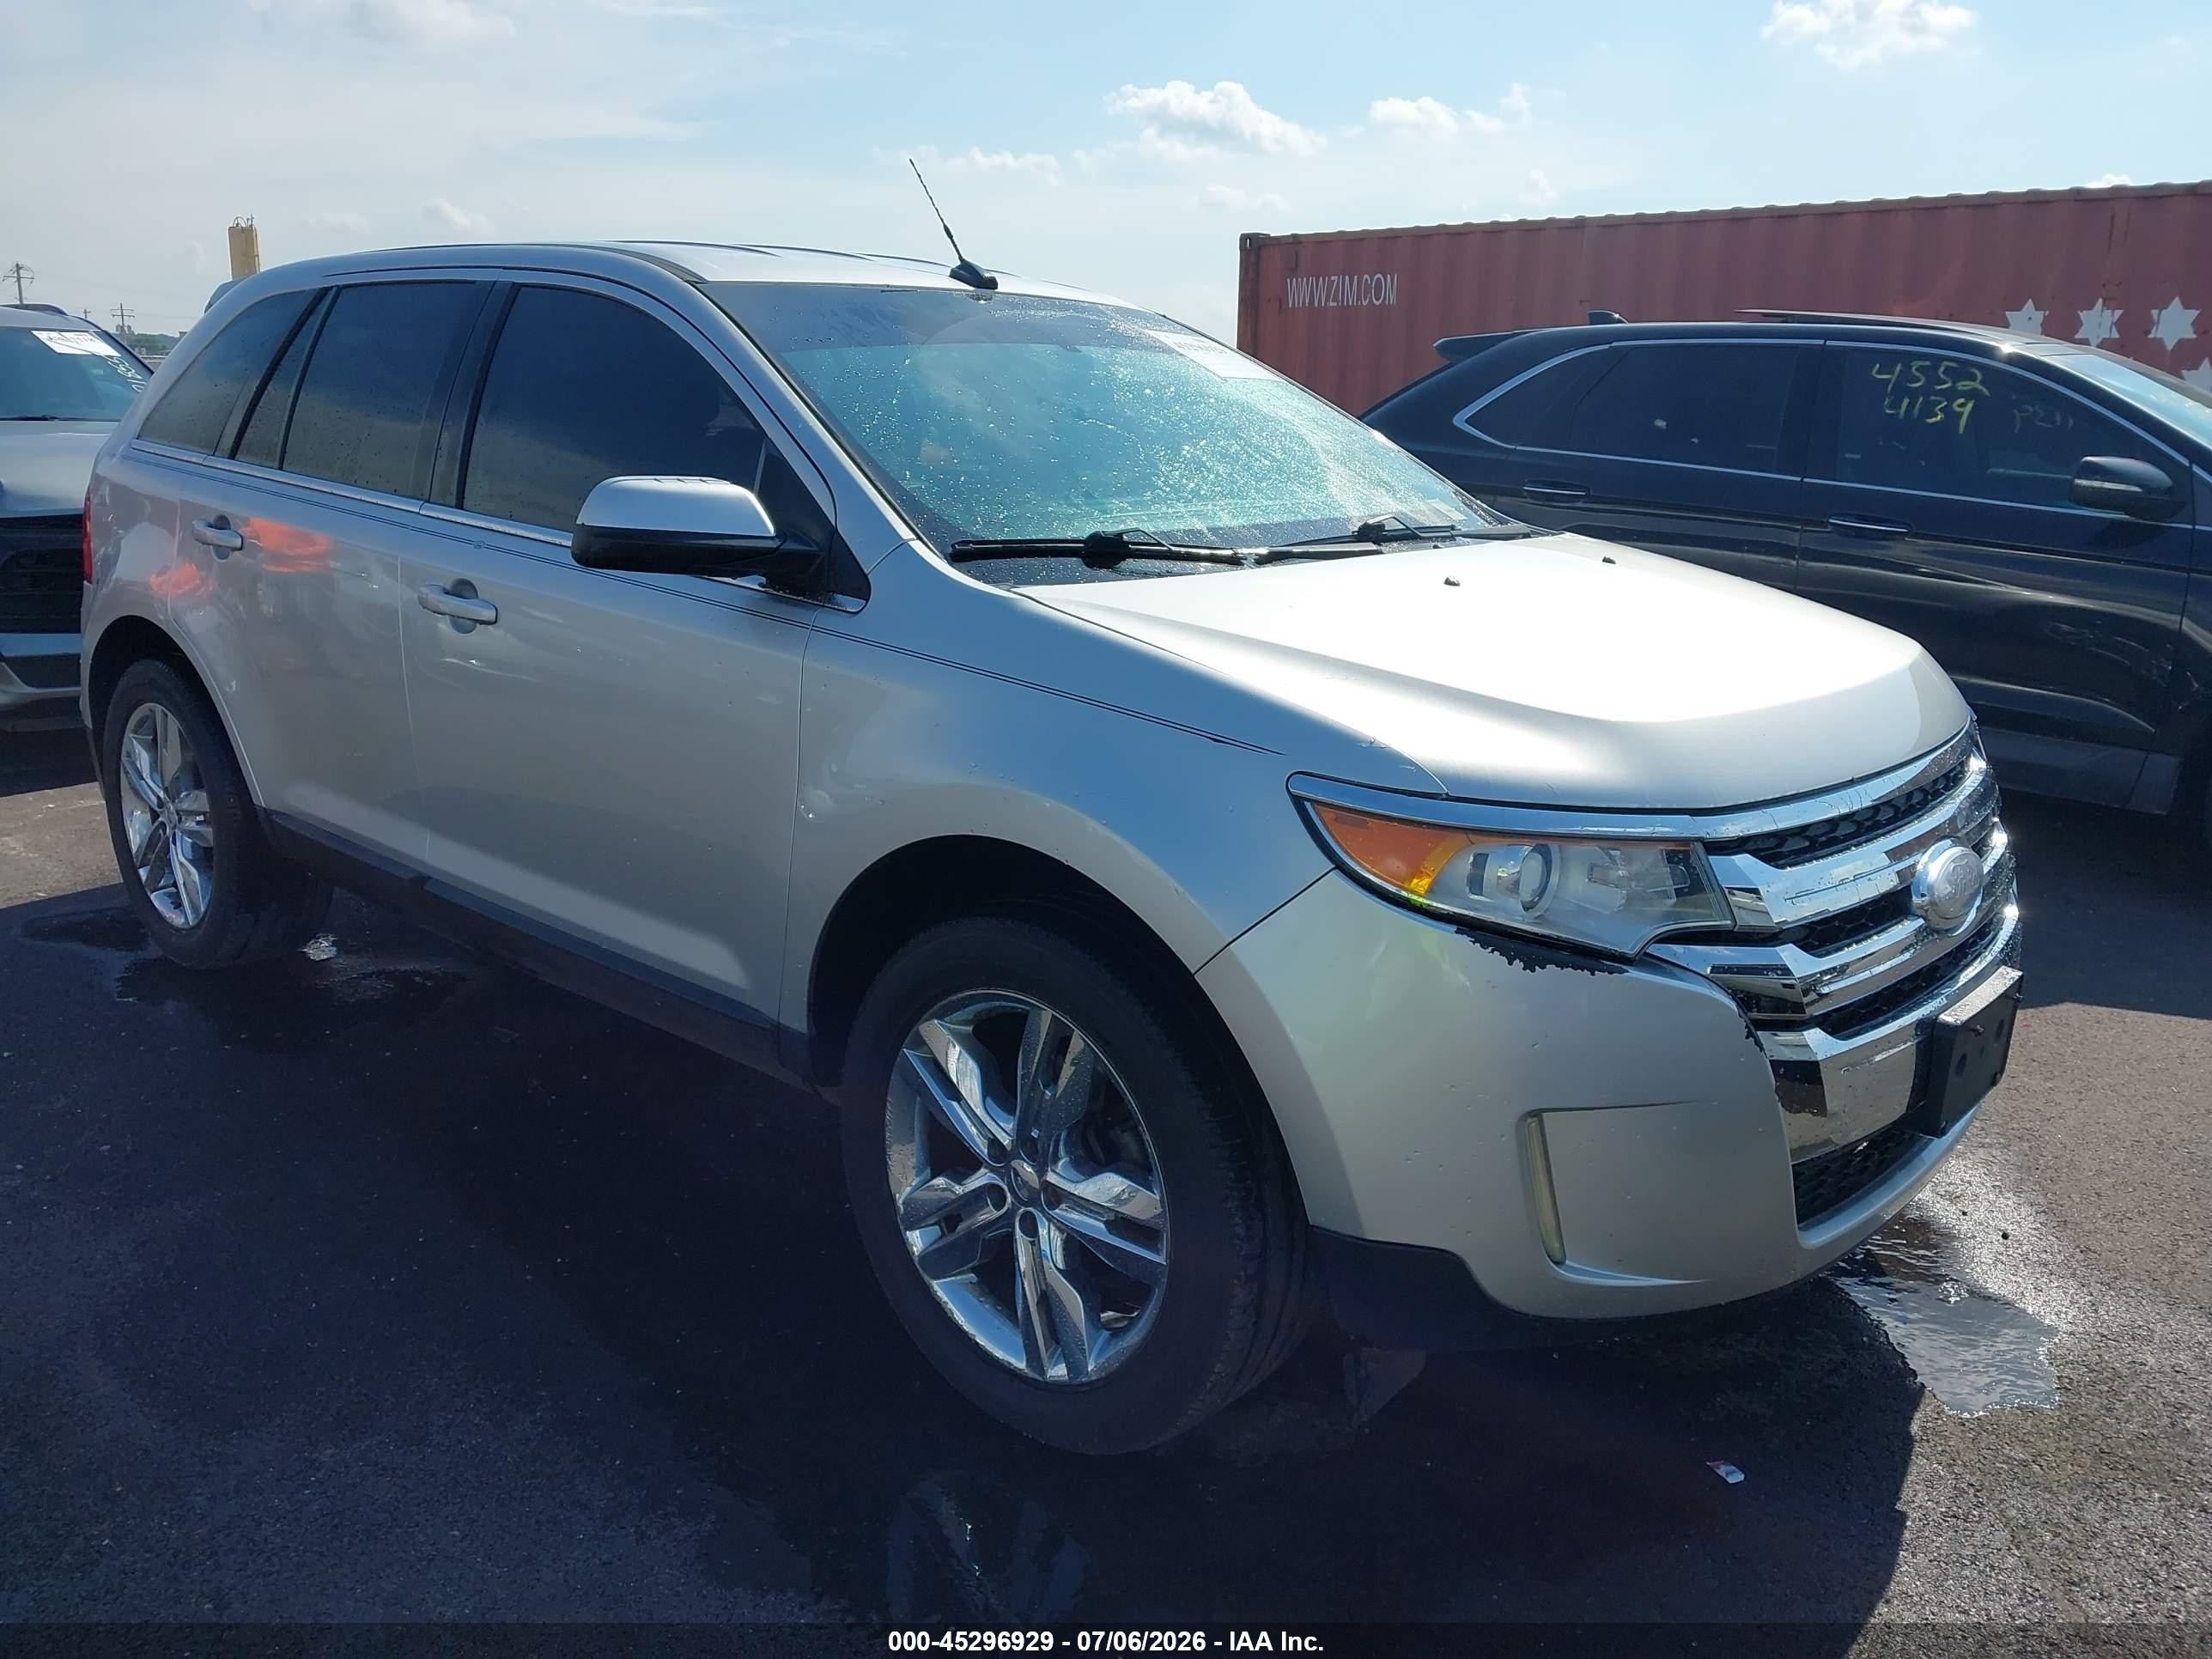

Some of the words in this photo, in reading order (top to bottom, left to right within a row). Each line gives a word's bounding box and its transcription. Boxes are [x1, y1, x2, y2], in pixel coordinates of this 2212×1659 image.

[1286, 273, 1398, 308] WWW.ZIM.COM
[1871, 360, 1990, 397] 4552
[1883, 396, 1975, 434] 4139
